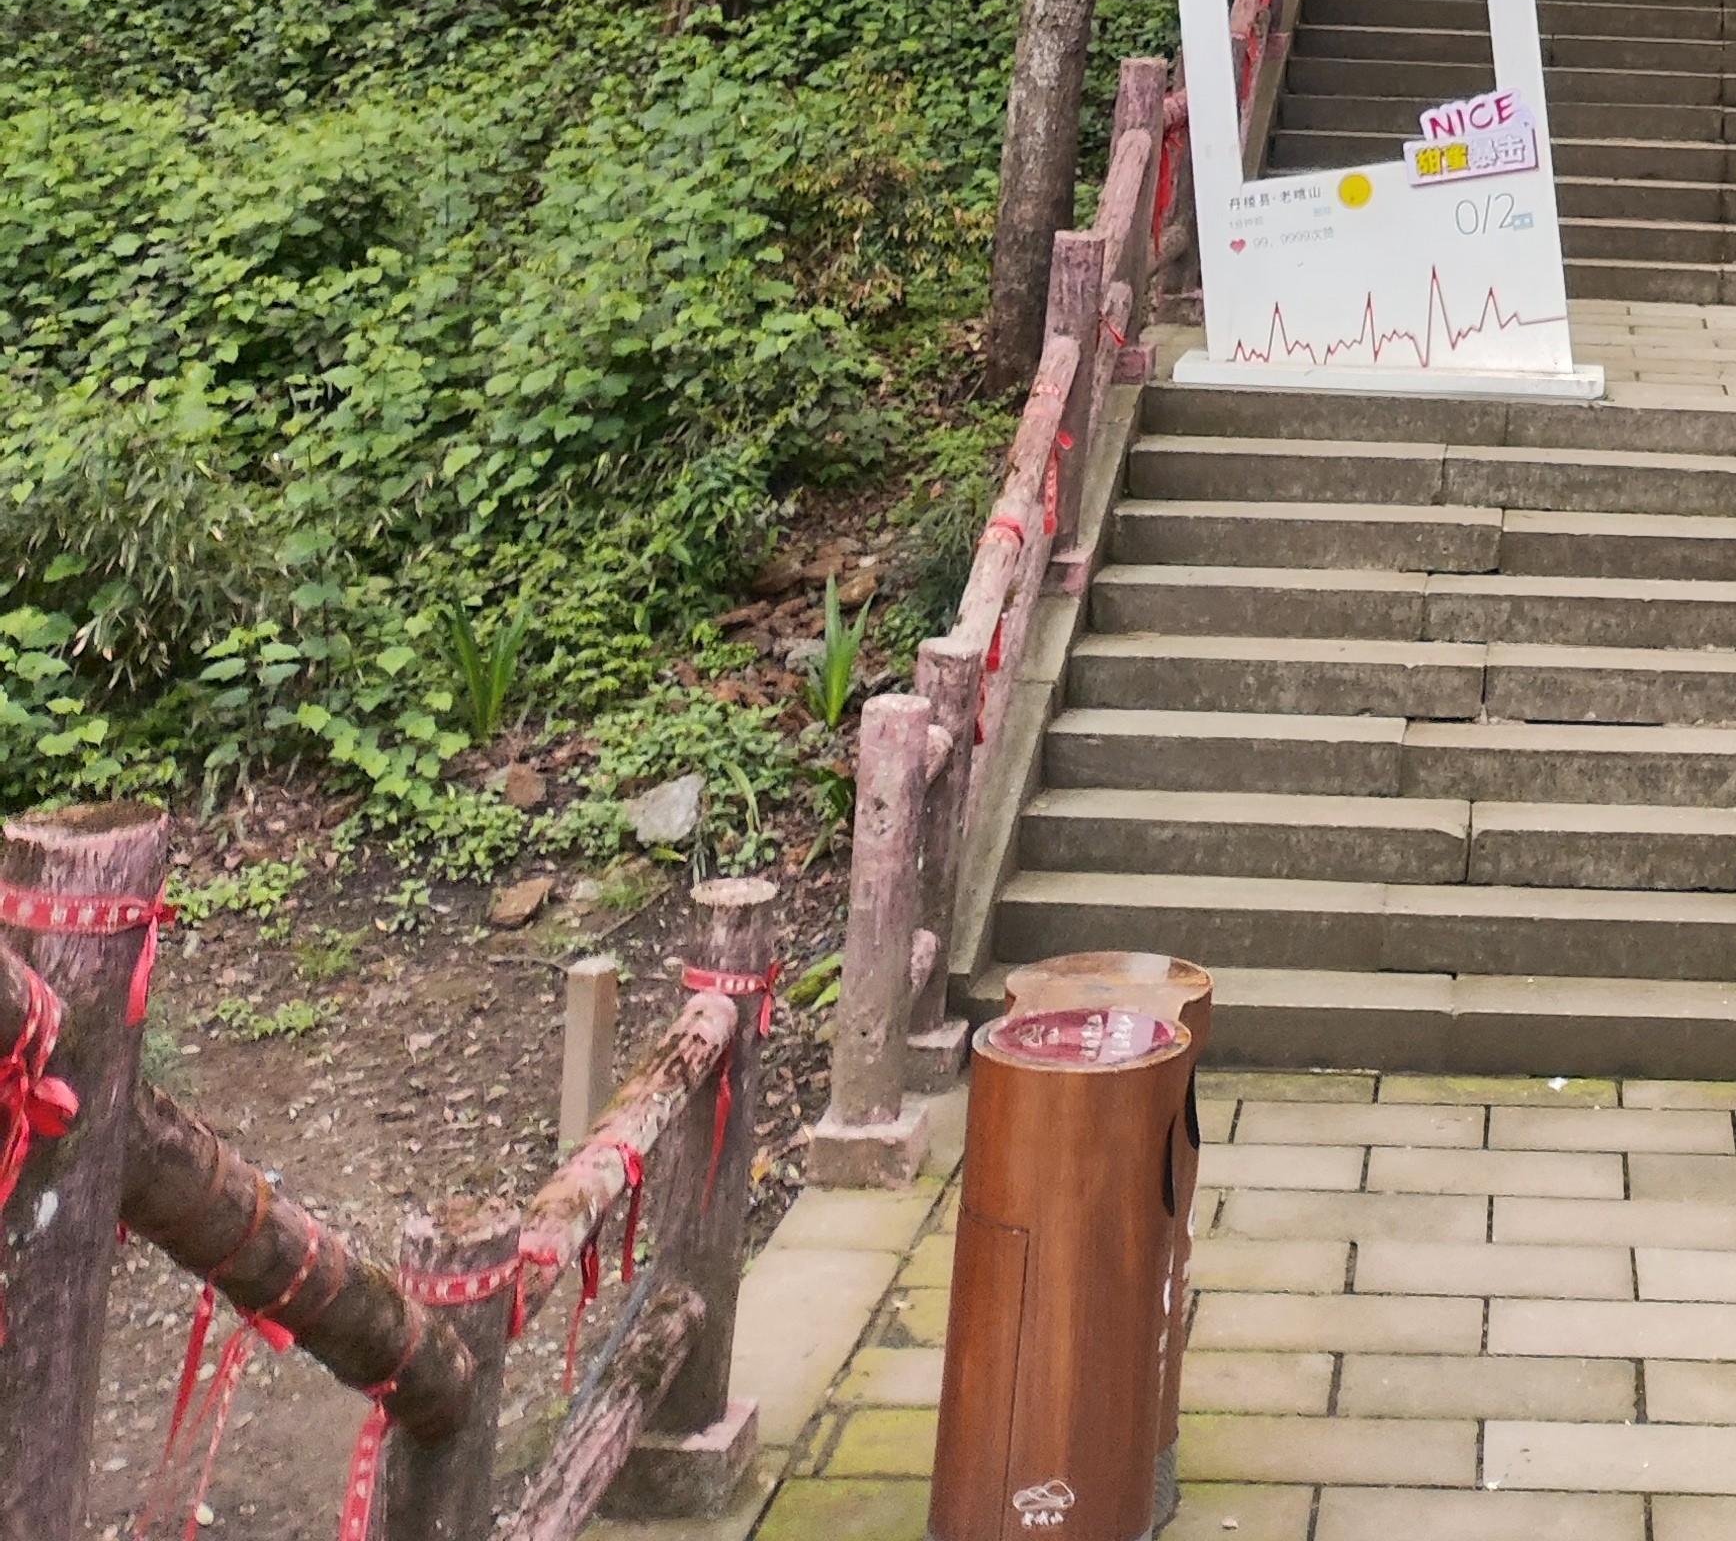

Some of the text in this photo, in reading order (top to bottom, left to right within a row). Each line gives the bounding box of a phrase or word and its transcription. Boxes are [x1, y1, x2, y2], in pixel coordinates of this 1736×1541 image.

[1429, 93, 1515, 140] NICE
[1415, 134, 1527, 176] 甜蜜暴击
